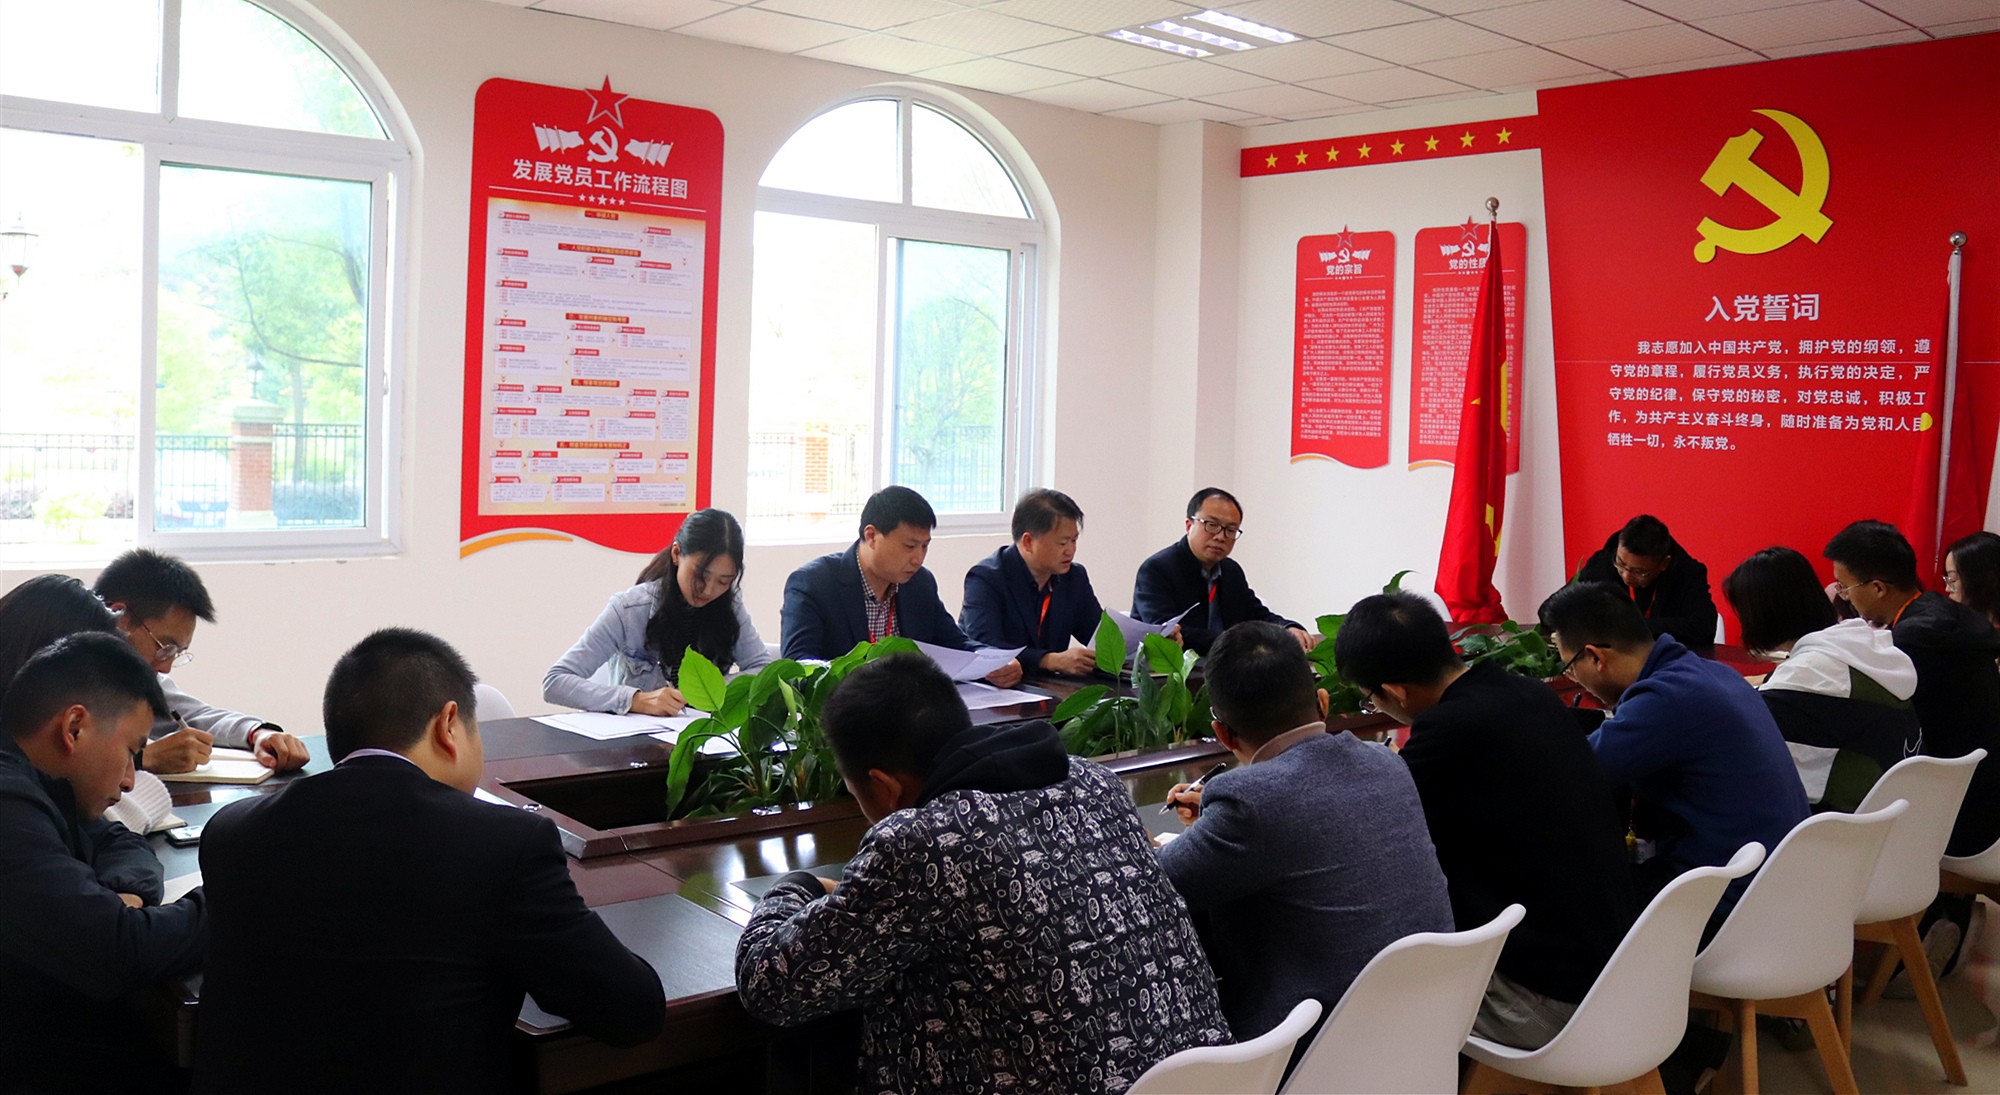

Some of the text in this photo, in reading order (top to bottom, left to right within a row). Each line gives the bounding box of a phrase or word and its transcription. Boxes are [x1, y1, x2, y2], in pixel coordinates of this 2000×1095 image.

[512, 158, 688, 199] 发展党员工作流程图
[1326, 263, 1362, 276] 党的宗旨
[1705, 293, 1820, 322] 入党誓词
[1637, 339, 1930, 355] 我志愿加入中国共产党，拥护党的纲领，遵
[1610, 364, 1930, 381] 守党的章程，履行党员义务，执行党的决定，严
[1607, 433, 1737, 451] 牺牲一切，永不叛党。
